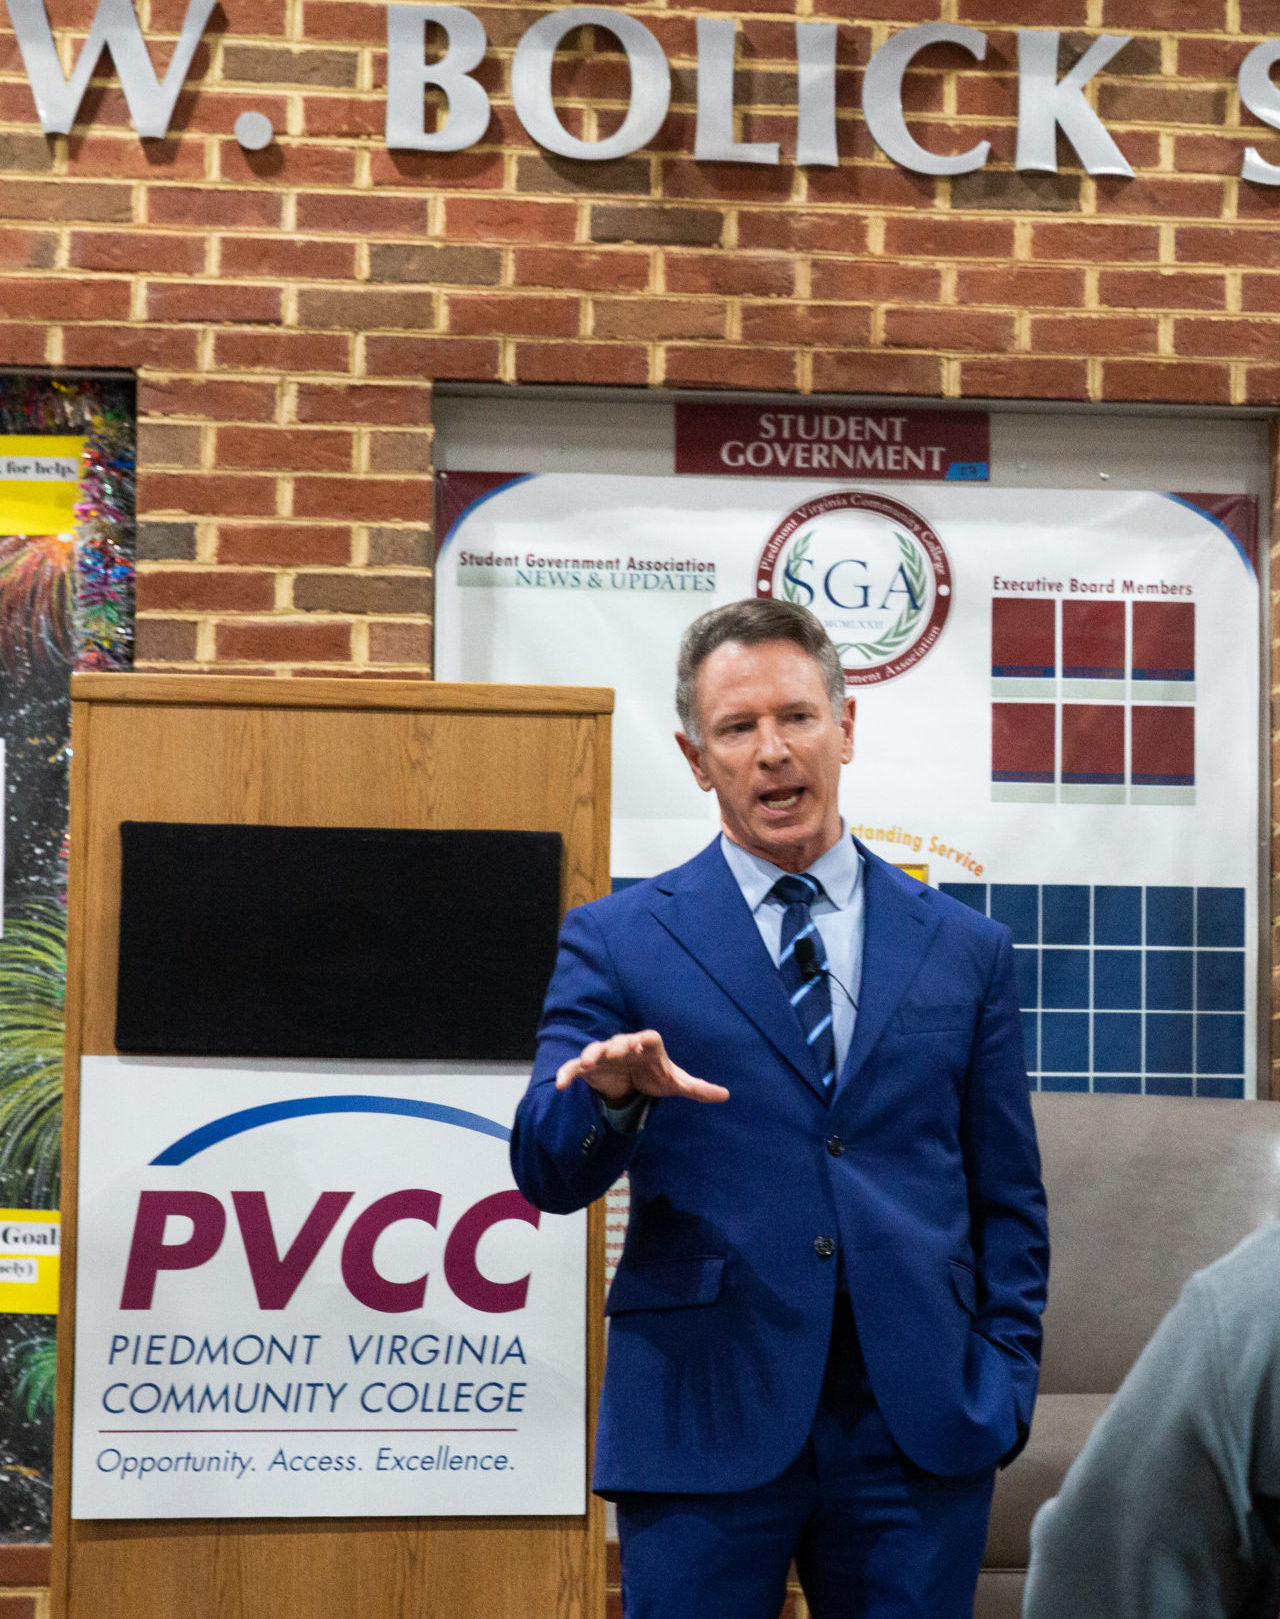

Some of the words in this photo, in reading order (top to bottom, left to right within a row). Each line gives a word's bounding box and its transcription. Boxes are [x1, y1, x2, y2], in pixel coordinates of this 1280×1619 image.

[6, 0, 274, 150] W.
[386, 4, 1135, 178] BOLICK
[759, 413, 908, 442] STUDENT
[6, 461, 31, 475] for
[720, 441, 946, 471] GOVERNMENT
[760, 519, 798, 572] Piedmont
[796, 496, 848, 519] Virginia
[921, 530, 946, 576] College
[459, 551, 519, 567] Student
[526, 553, 620, 570] Government
[626, 556, 716, 573] Association
[515, 569, 582, 588] NEWS
[587, 573, 604, 588] &
[610, 572, 716, 592] UPDATES
[784, 558, 921, 610] SGA
[992, 576, 1064, 592] Executive
[1069, 578, 1115, 594] Board
[1121, 579, 1194, 596] Members
[885, 626, 941, 678] Association
[928, 835, 985, 877] Service
[119, 1188, 542, 1313] PVCC
[108, 1334, 322, 1365] PIEDMONT
[348, 1334, 527, 1365] VIRGINIA
[102, 1382, 349, 1414] COMMUNITY
[360, 1382, 527, 1414] COLLEGE
[96, 1448, 256, 1481] Opportunity.
[267, 1447, 363, 1472] Access.
[375, 1445, 515, 1472] Excellence.
